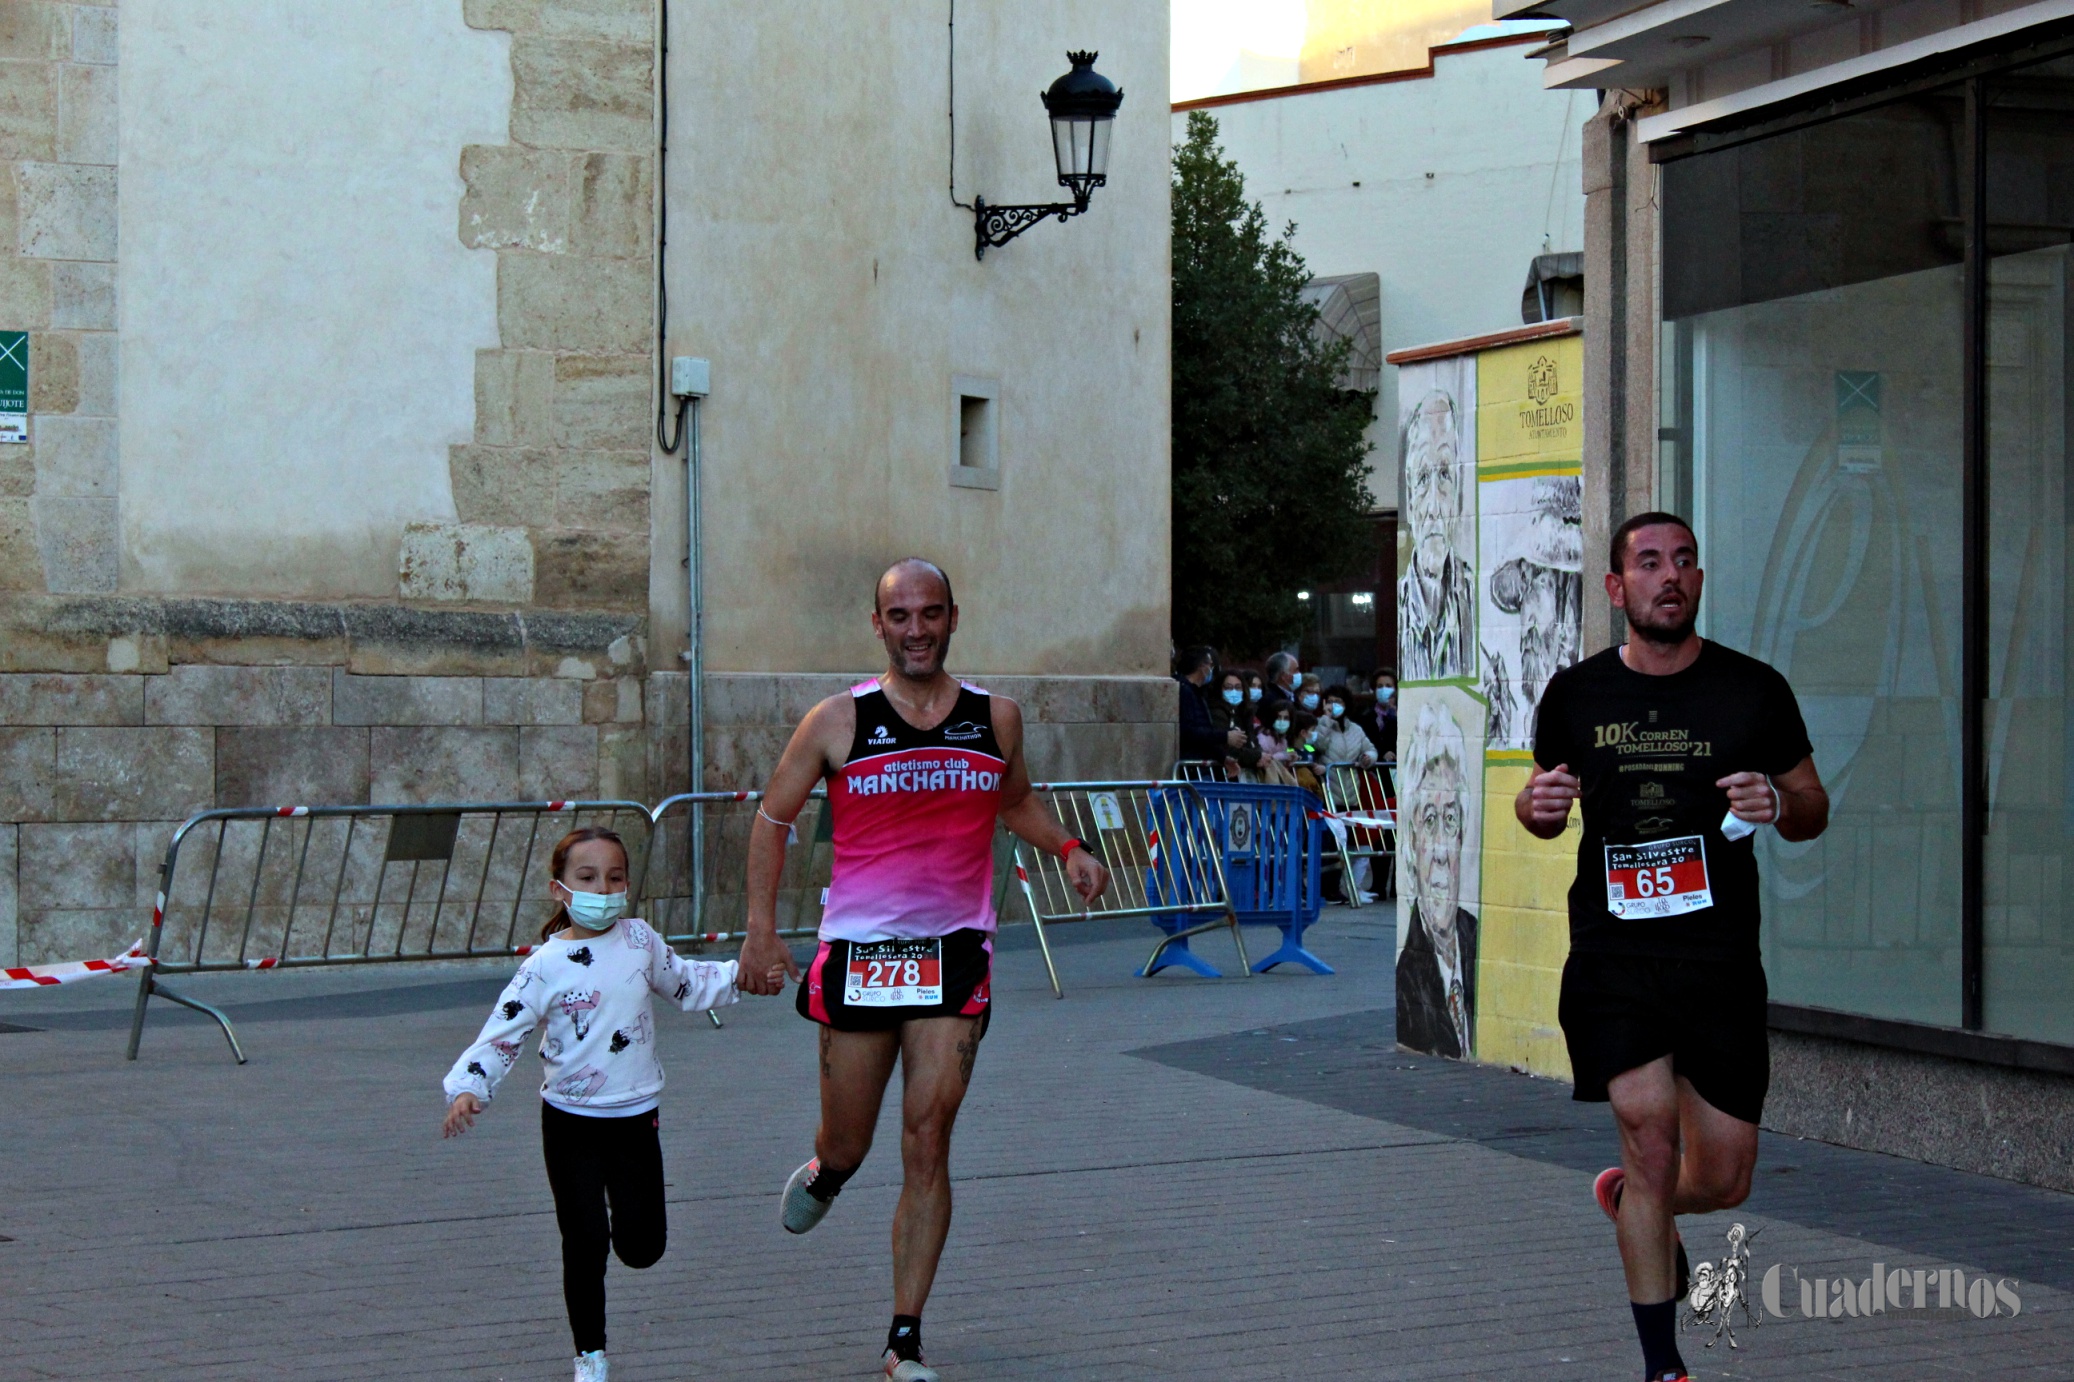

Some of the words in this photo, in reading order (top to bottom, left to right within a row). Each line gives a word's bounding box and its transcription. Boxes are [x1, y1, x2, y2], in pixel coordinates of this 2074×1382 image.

[1519, 403, 1574, 429] TOMELLOSO
[867, 737, 897, 746] VIATOR
[944, 733, 982, 741] MANCHATHON
[1594, 721, 1639, 748] 10K
[883, 759, 940, 773] atletismo
[944, 758, 969, 769] club
[1630, 798, 1676, 806] TOMELLOSO
[1612, 853, 1633, 862] San
[1636, 846, 1695, 861] Silvestre
[1612, 859, 1668, 870] Tomellosera
[1636, 866, 1675, 898] 65
[866, 960, 921, 987] 278
